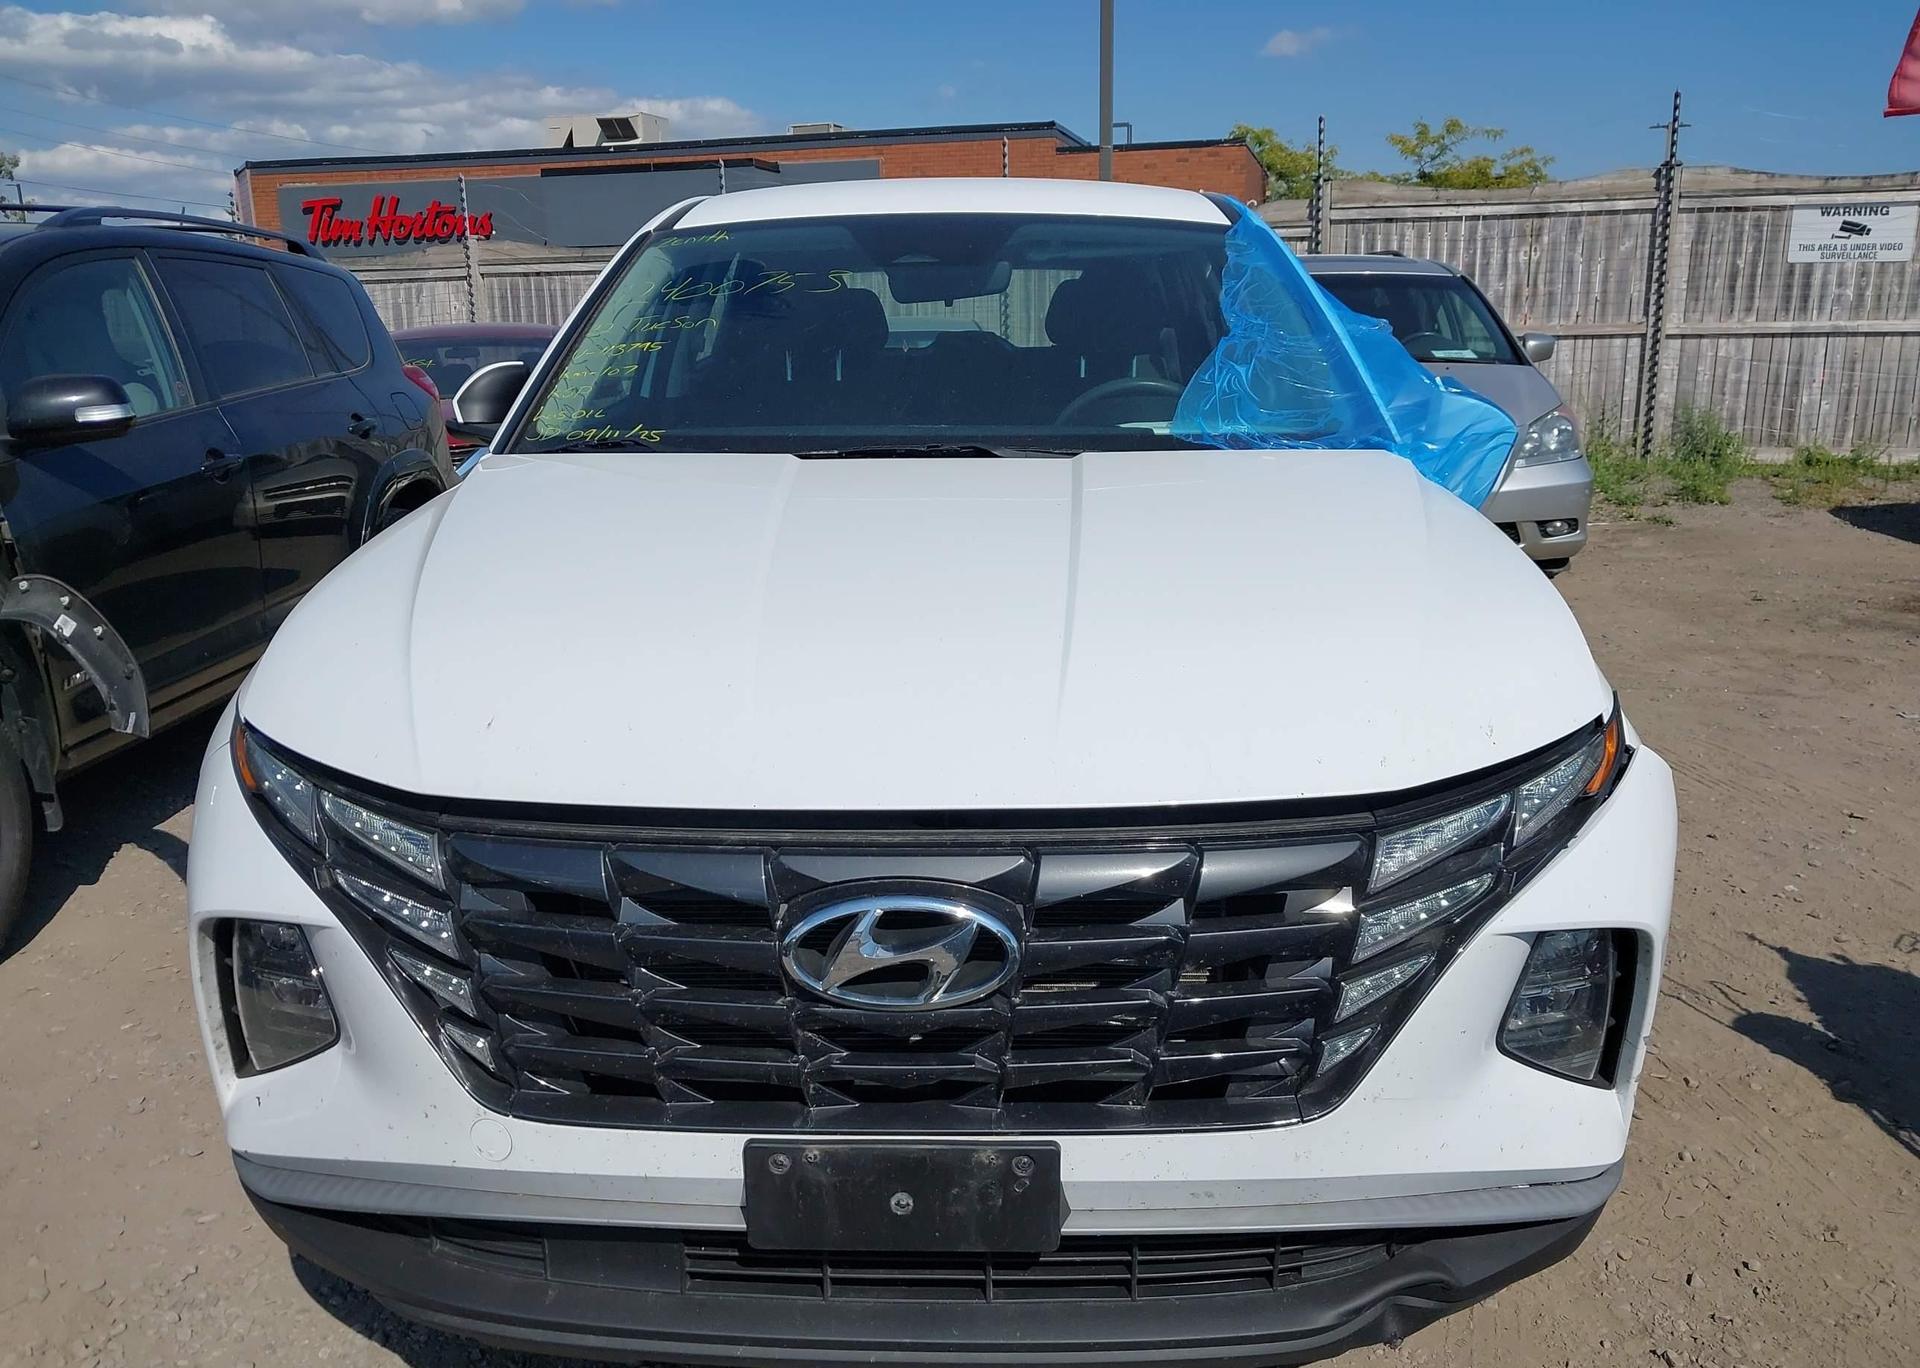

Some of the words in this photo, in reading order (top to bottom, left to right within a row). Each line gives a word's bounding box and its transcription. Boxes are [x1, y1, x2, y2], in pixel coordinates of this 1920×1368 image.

[1820, 206, 1890, 217] WARNING
[302, 197, 362, 246] Tim
[367, 193, 493, 246] Hortons
[1798, 243, 1816, 252] THIS
[1818, 243, 1838, 252] AREA
[1840, 243, 1848, 252] IS
[1850, 243, 1877, 252] UNDER
[1879, 242, 1903, 251] VIDEO
[1820, 251, 1878, 260] SURVEILLANCE
